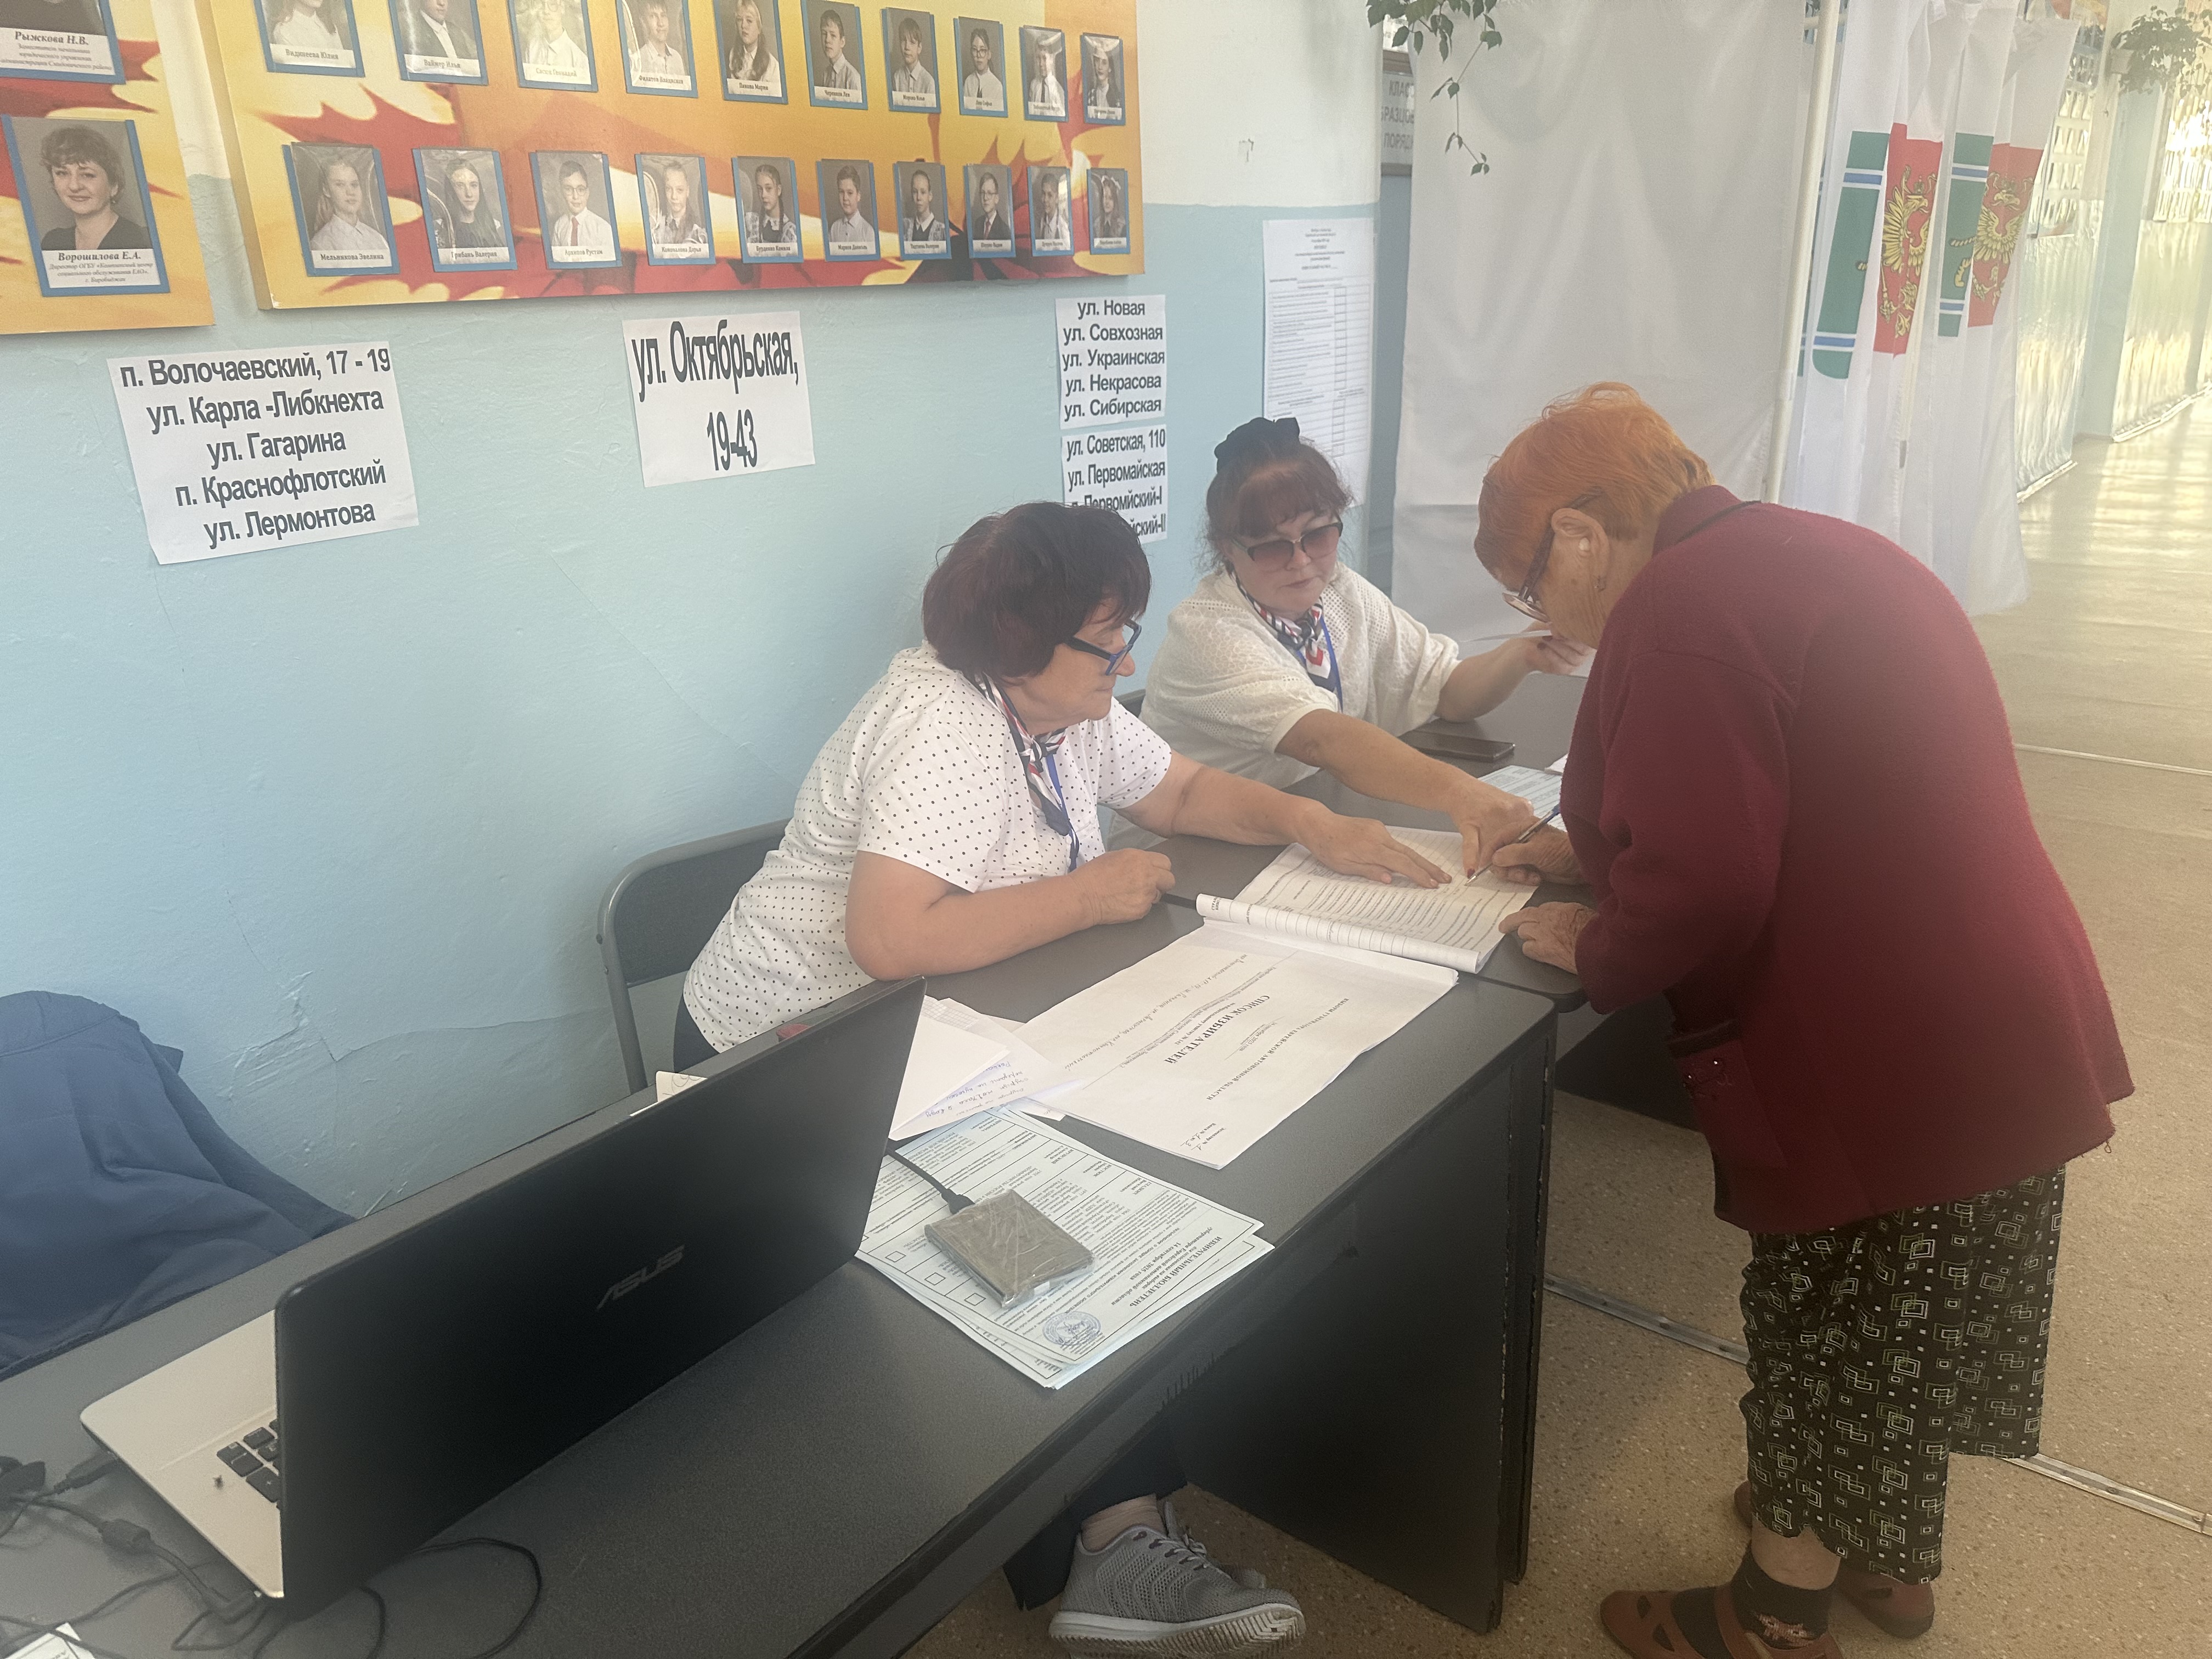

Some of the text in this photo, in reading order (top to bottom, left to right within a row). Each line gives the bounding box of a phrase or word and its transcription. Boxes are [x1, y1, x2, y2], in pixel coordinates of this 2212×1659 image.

[15, 31, 89, 46] Рыжкова Н.В.
[58, 251, 141, 263] Ворошилова Е.А.
[1077, 300, 1146, 320] ул. Новая
[1063, 323, 1163, 346] ул. Совхозная
[120, 366, 144, 387] п.
[148, 352, 321, 386] Волочаевский,
[326, 350, 349, 376] 17
[367, 348, 392, 373] 19
[631, 319, 799, 403] ул. Октябрьская,
[1062, 349, 1165, 372] ул. Украинская
[1066, 374, 1161, 397] ул. Некрасова
[146, 405, 184, 435] ул.
[189, 396, 261, 428] Карла
[1064, 398, 1162, 422] ул. Сибирская
[207, 430, 347, 470] ул. Гагарина
[707, 409, 758, 471] 19-43
[1066, 428, 1166, 462] ул. Советская, 110
[175, 459, 387, 509] п. Краснофлотский
[1068, 459, 1166, 493] ул. Первомайская
[203, 502, 376, 550] ул. Лермонтова
[1229, 995, 1271, 1015] СПИСОК
[1327, 998, 1350, 1012] ВЫБОРЫ
[1184, 1023, 1203, 1036] участку
[1295, 1012, 1330, 1030] ГУБЕРНАТОРА
[1163, 1014, 1234, 1064] ИЗБИРАТЕЛЕЙ
[1246, 1036, 1259, 1045] 2025
[1266, 1029, 1297, 1054] ЕВРЕЙСКОЙ
[1231, 1054, 1269, 1081] АВТОНОМНОЙ
[1205, 1080, 1234, 1100] ОБЛАСТИ
[1183, 1226, 1214, 1249] губернатора
[1150, 1245, 1176, 1263] сентября
[1160, 1247, 1187, 1267] Еврейской
[1168, 1235, 1223, 1277] ИЗБИРАТЕЛЬНЫЙ
[596, 1244, 685, 1310] ASUS
[1128, 1271, 1143, 1281] года
[1131, 1265, 1164, 1290] автономной
[1139, 1262, 1154, 1272] 2025
[1110, 1288, 1135, 1306] области
[1127, 1274, 1172, 1308] БЮЛЛЕТЕНЬ
